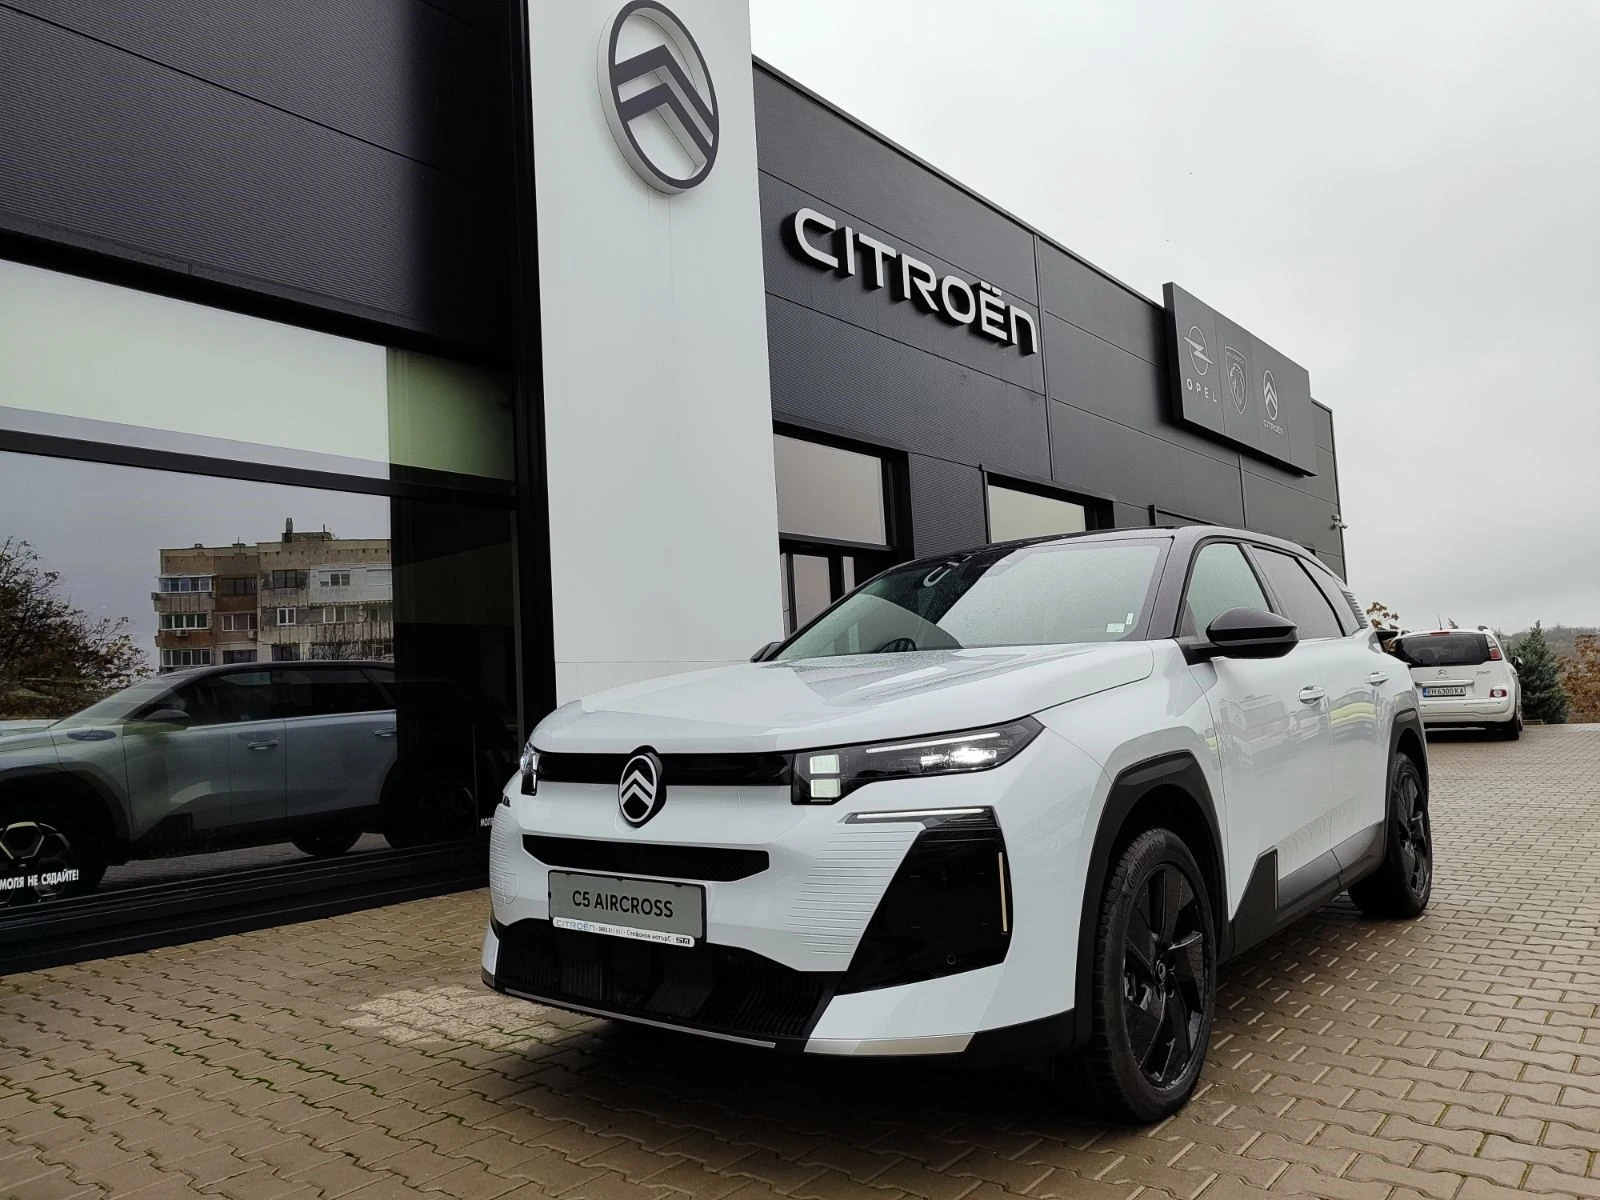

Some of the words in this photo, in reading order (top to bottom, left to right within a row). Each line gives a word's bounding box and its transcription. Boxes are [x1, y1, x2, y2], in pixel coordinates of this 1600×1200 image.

[794, 207, 1038, 354] CITROËN
[1186, 377, 1218, 403] OPEL
[0, 876, 25, 890] МОЛЯ
[28, 874, 39, 887] НЕ
[41, 868, 79, 885] СЯДАЙТЕ!
[572, 890, 591, 908] C5
[594, 893, 674, 918] AIRCROSS
